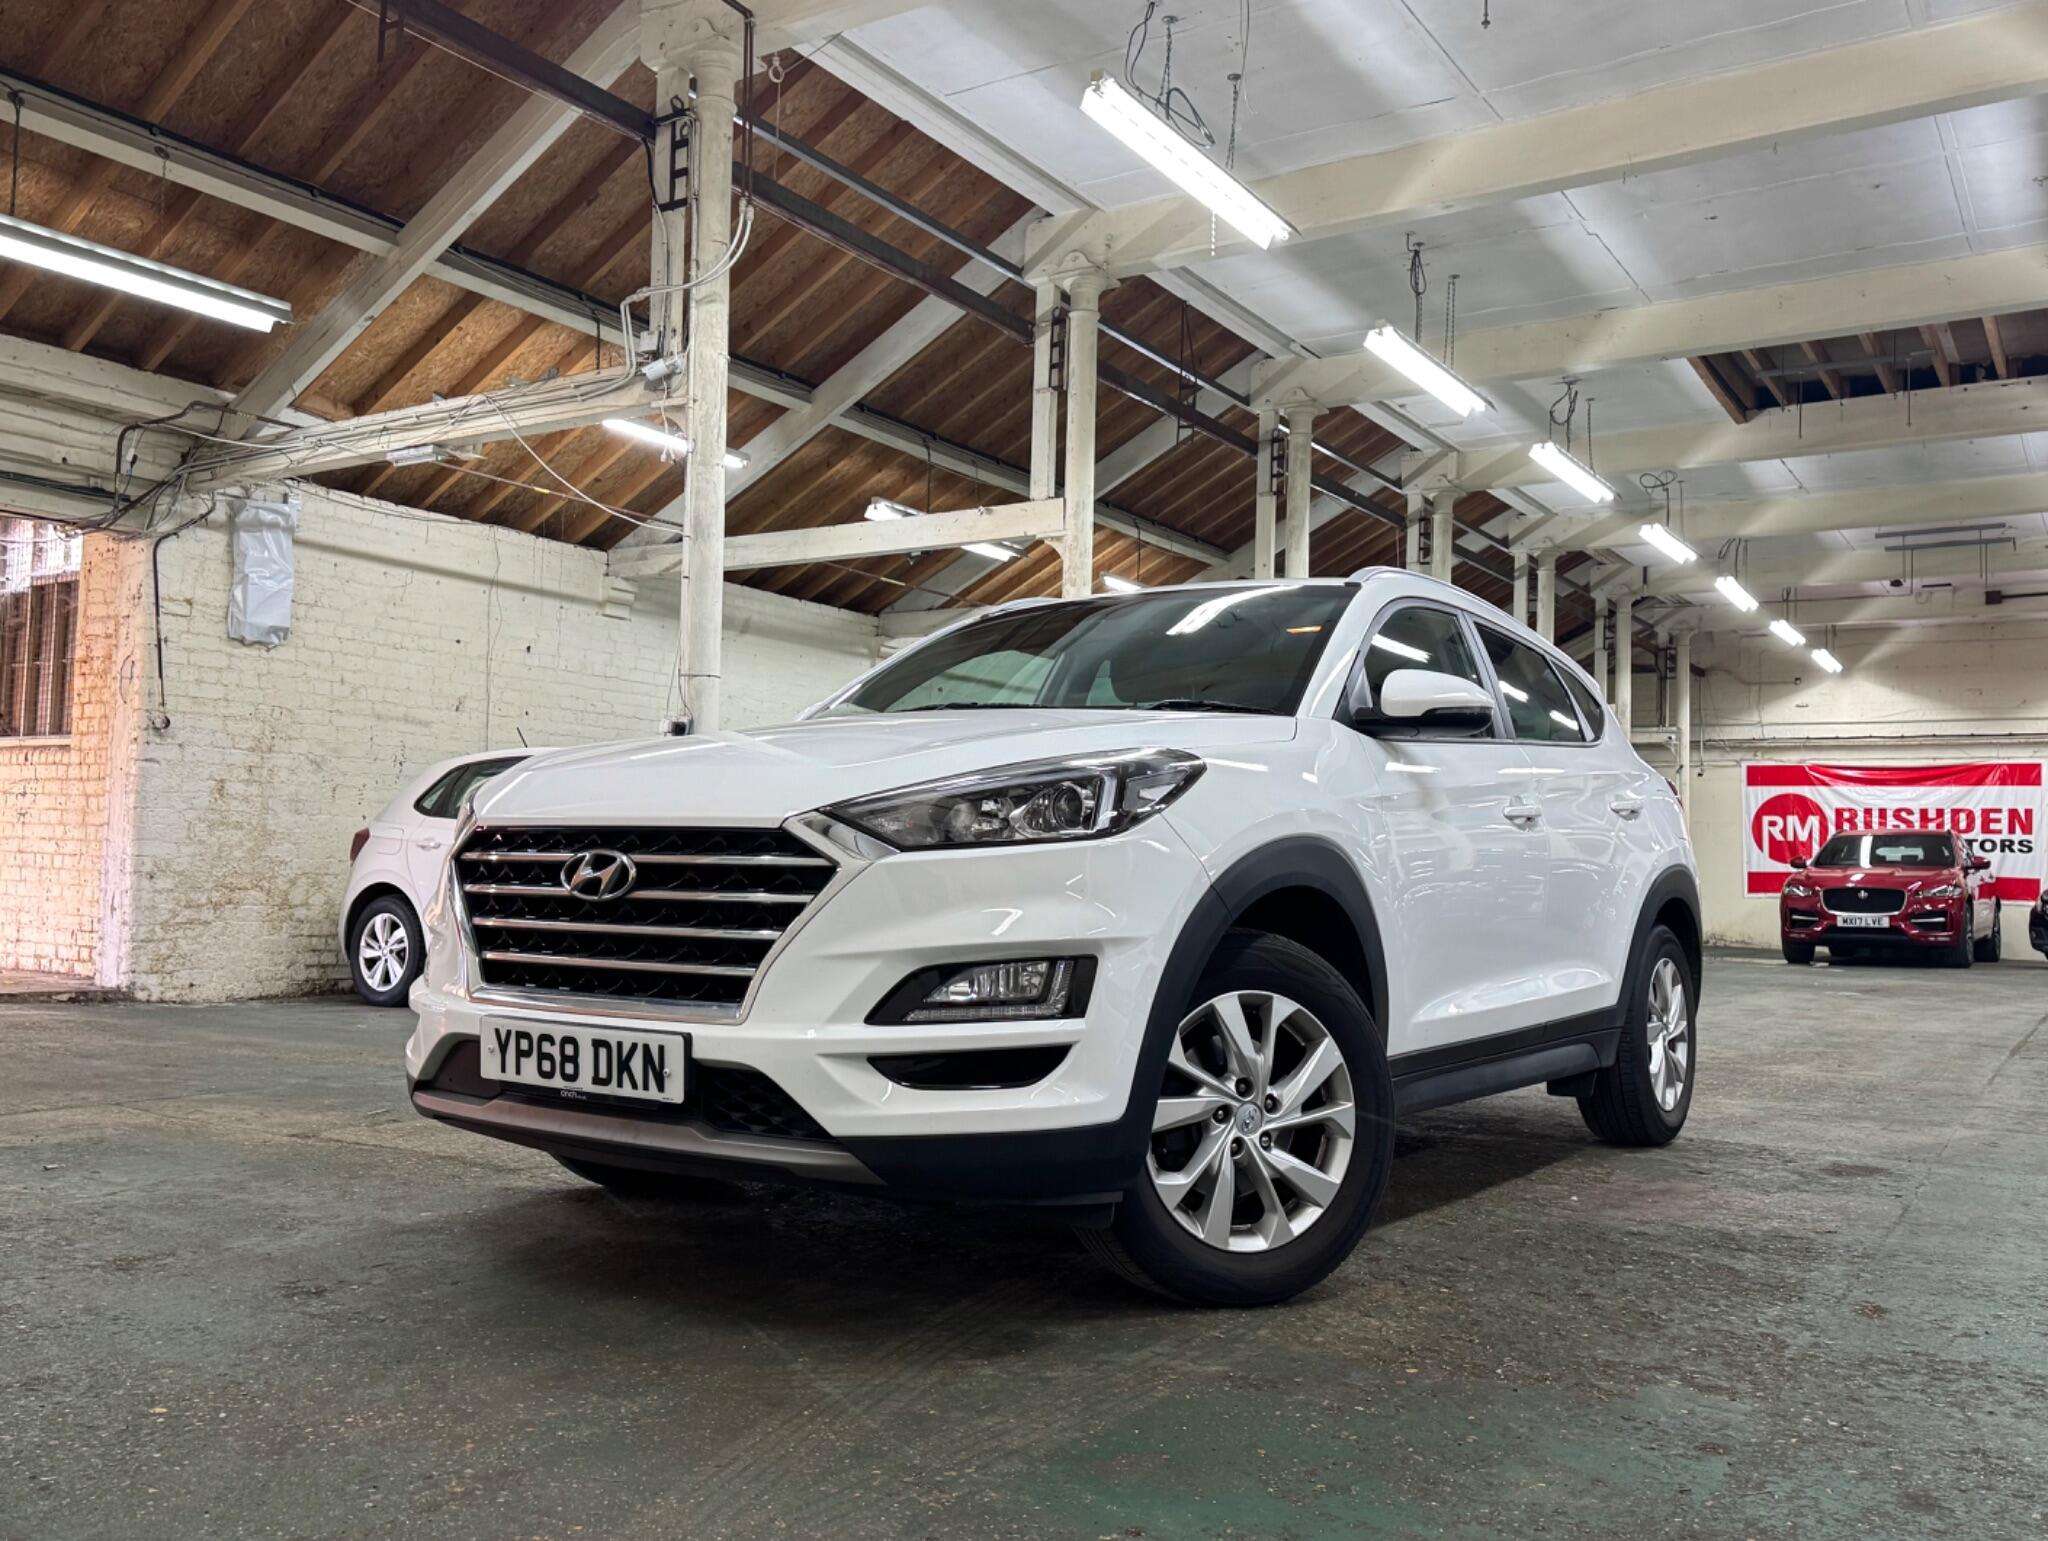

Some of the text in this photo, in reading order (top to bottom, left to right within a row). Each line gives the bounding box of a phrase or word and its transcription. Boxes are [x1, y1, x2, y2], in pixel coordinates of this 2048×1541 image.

[1761, 814, 1820, 856] RM
[1834, 806, 2034, 835] RUSHDEN
[1964, 838, 2035, 854] TORS
[494, 1027, 665, 1093] YP68 DKN
